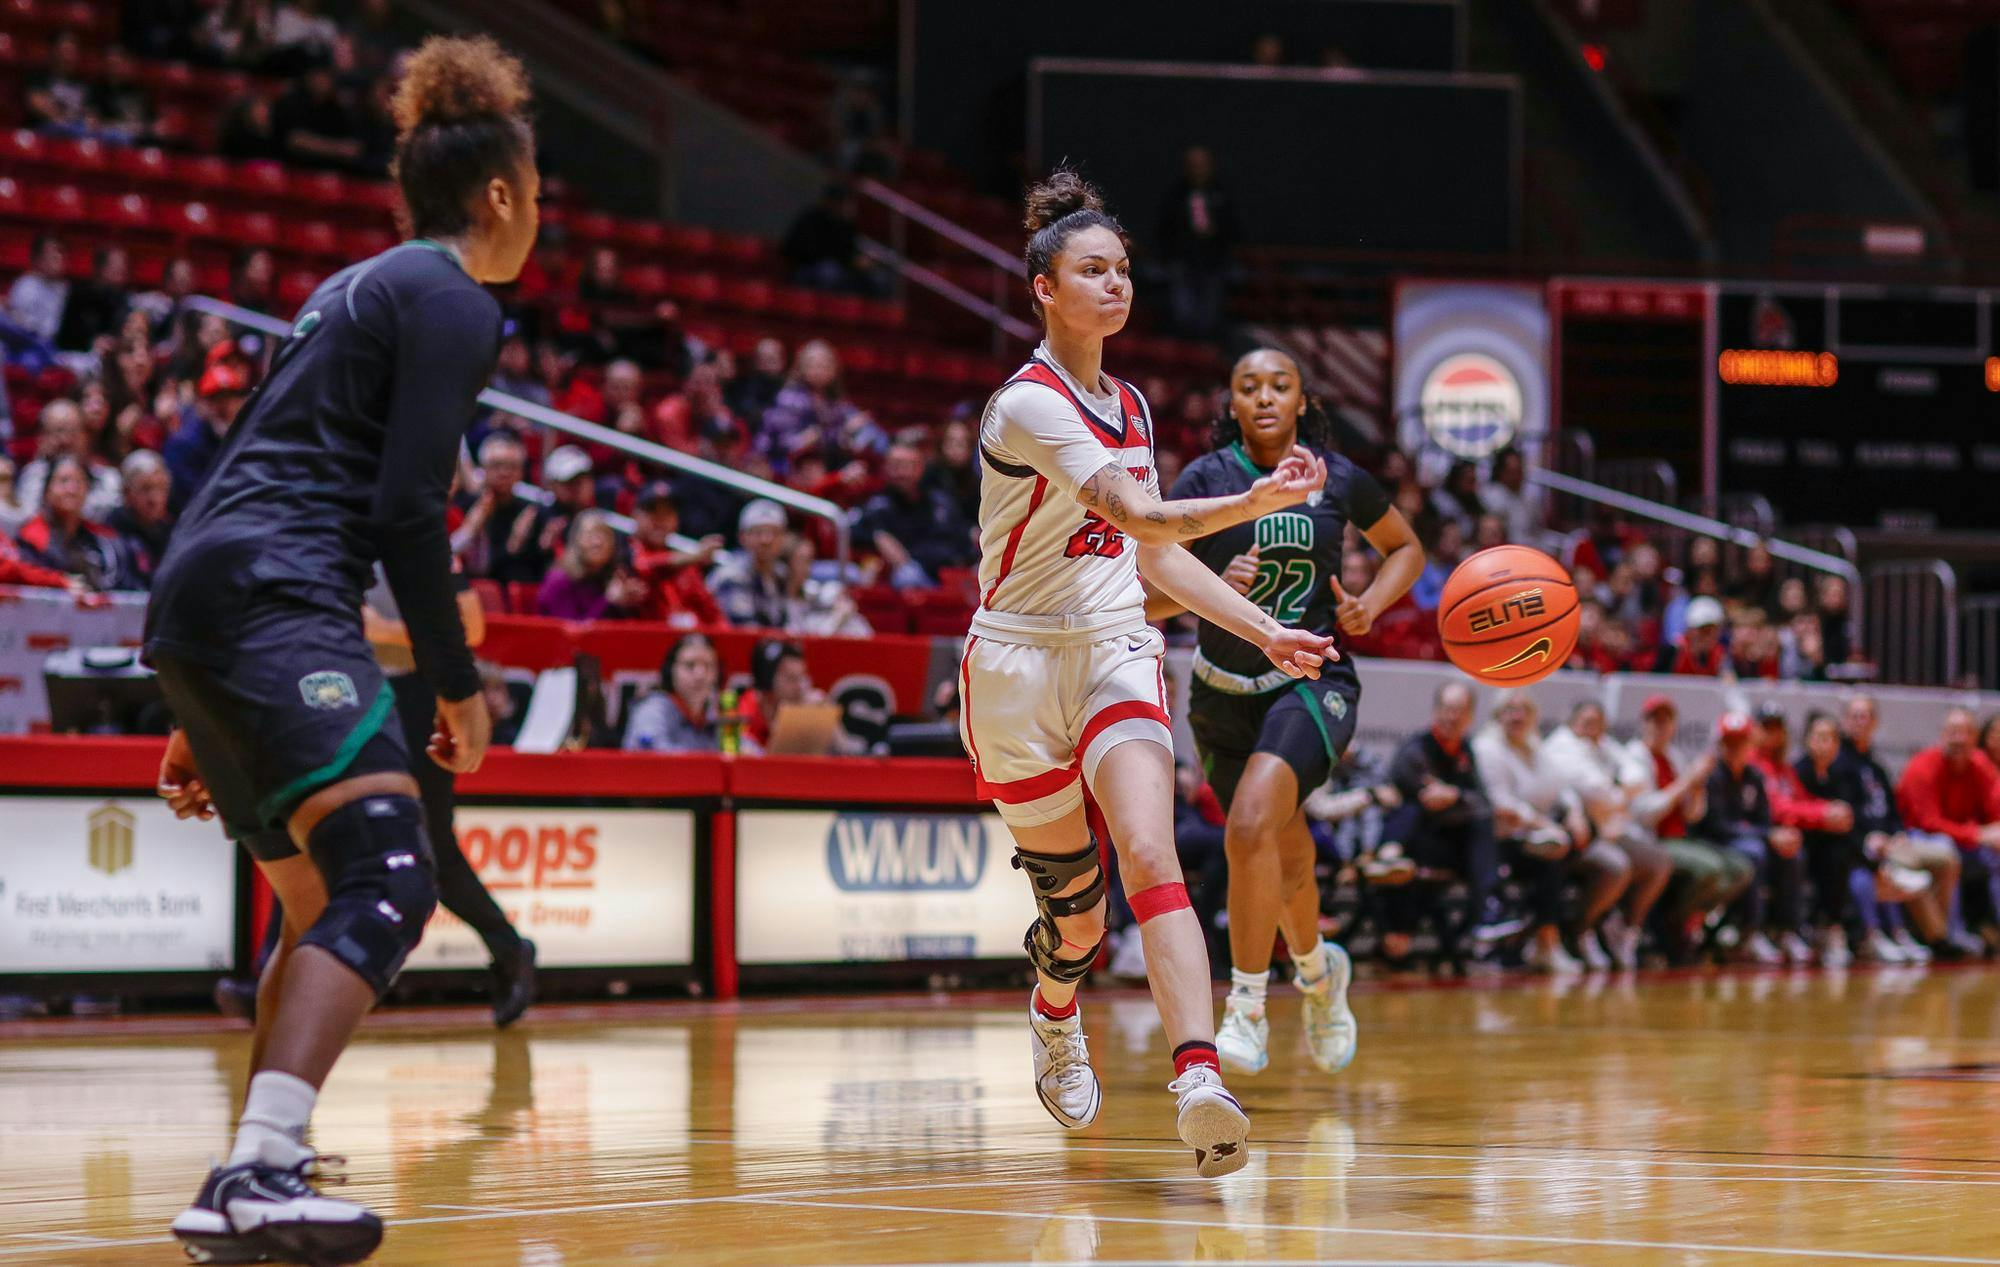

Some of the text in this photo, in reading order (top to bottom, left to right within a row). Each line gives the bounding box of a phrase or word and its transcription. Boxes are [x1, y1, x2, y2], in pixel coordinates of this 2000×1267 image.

[1255, 512, 1314, 552] OHIO
[1246, 560, 1316, 624] 22
[1468, 588, 1546, 634] ELITE
[452, 825, 598, 889] oops
[836, 817, 981, 885] WMUN
[530, 902, 592, 928] Group
